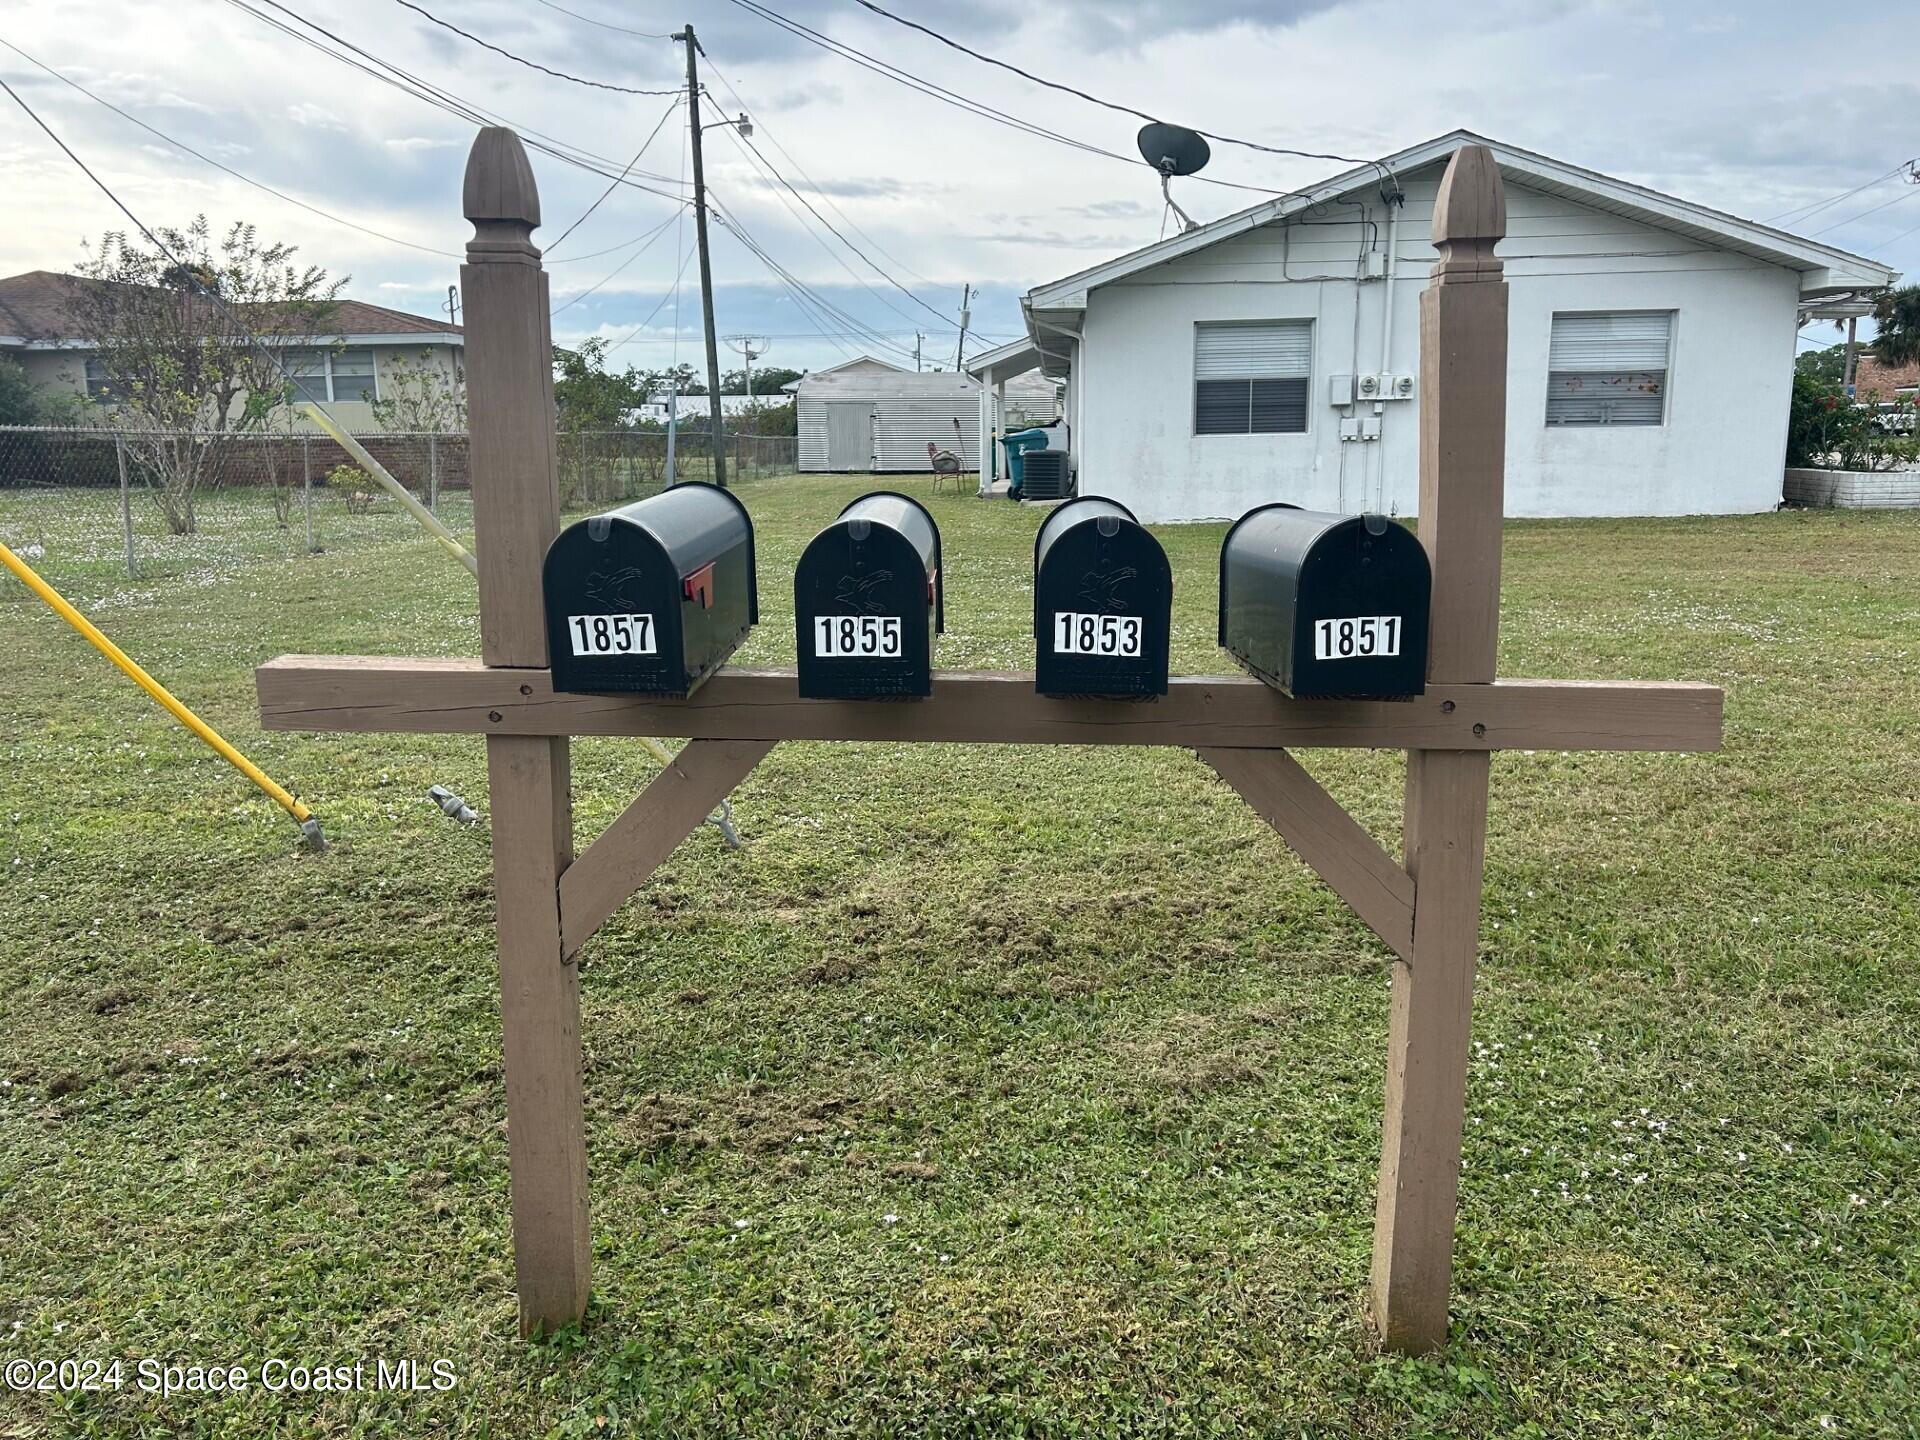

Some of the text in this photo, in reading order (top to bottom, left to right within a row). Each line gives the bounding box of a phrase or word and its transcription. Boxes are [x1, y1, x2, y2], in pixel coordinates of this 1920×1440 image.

[575, 616, 650, 652] 1857
[821, 618, 898, 654] 1855
[1061, 614, 1138, 654] 1853
[1321, 618, 1396, 656] 1851
